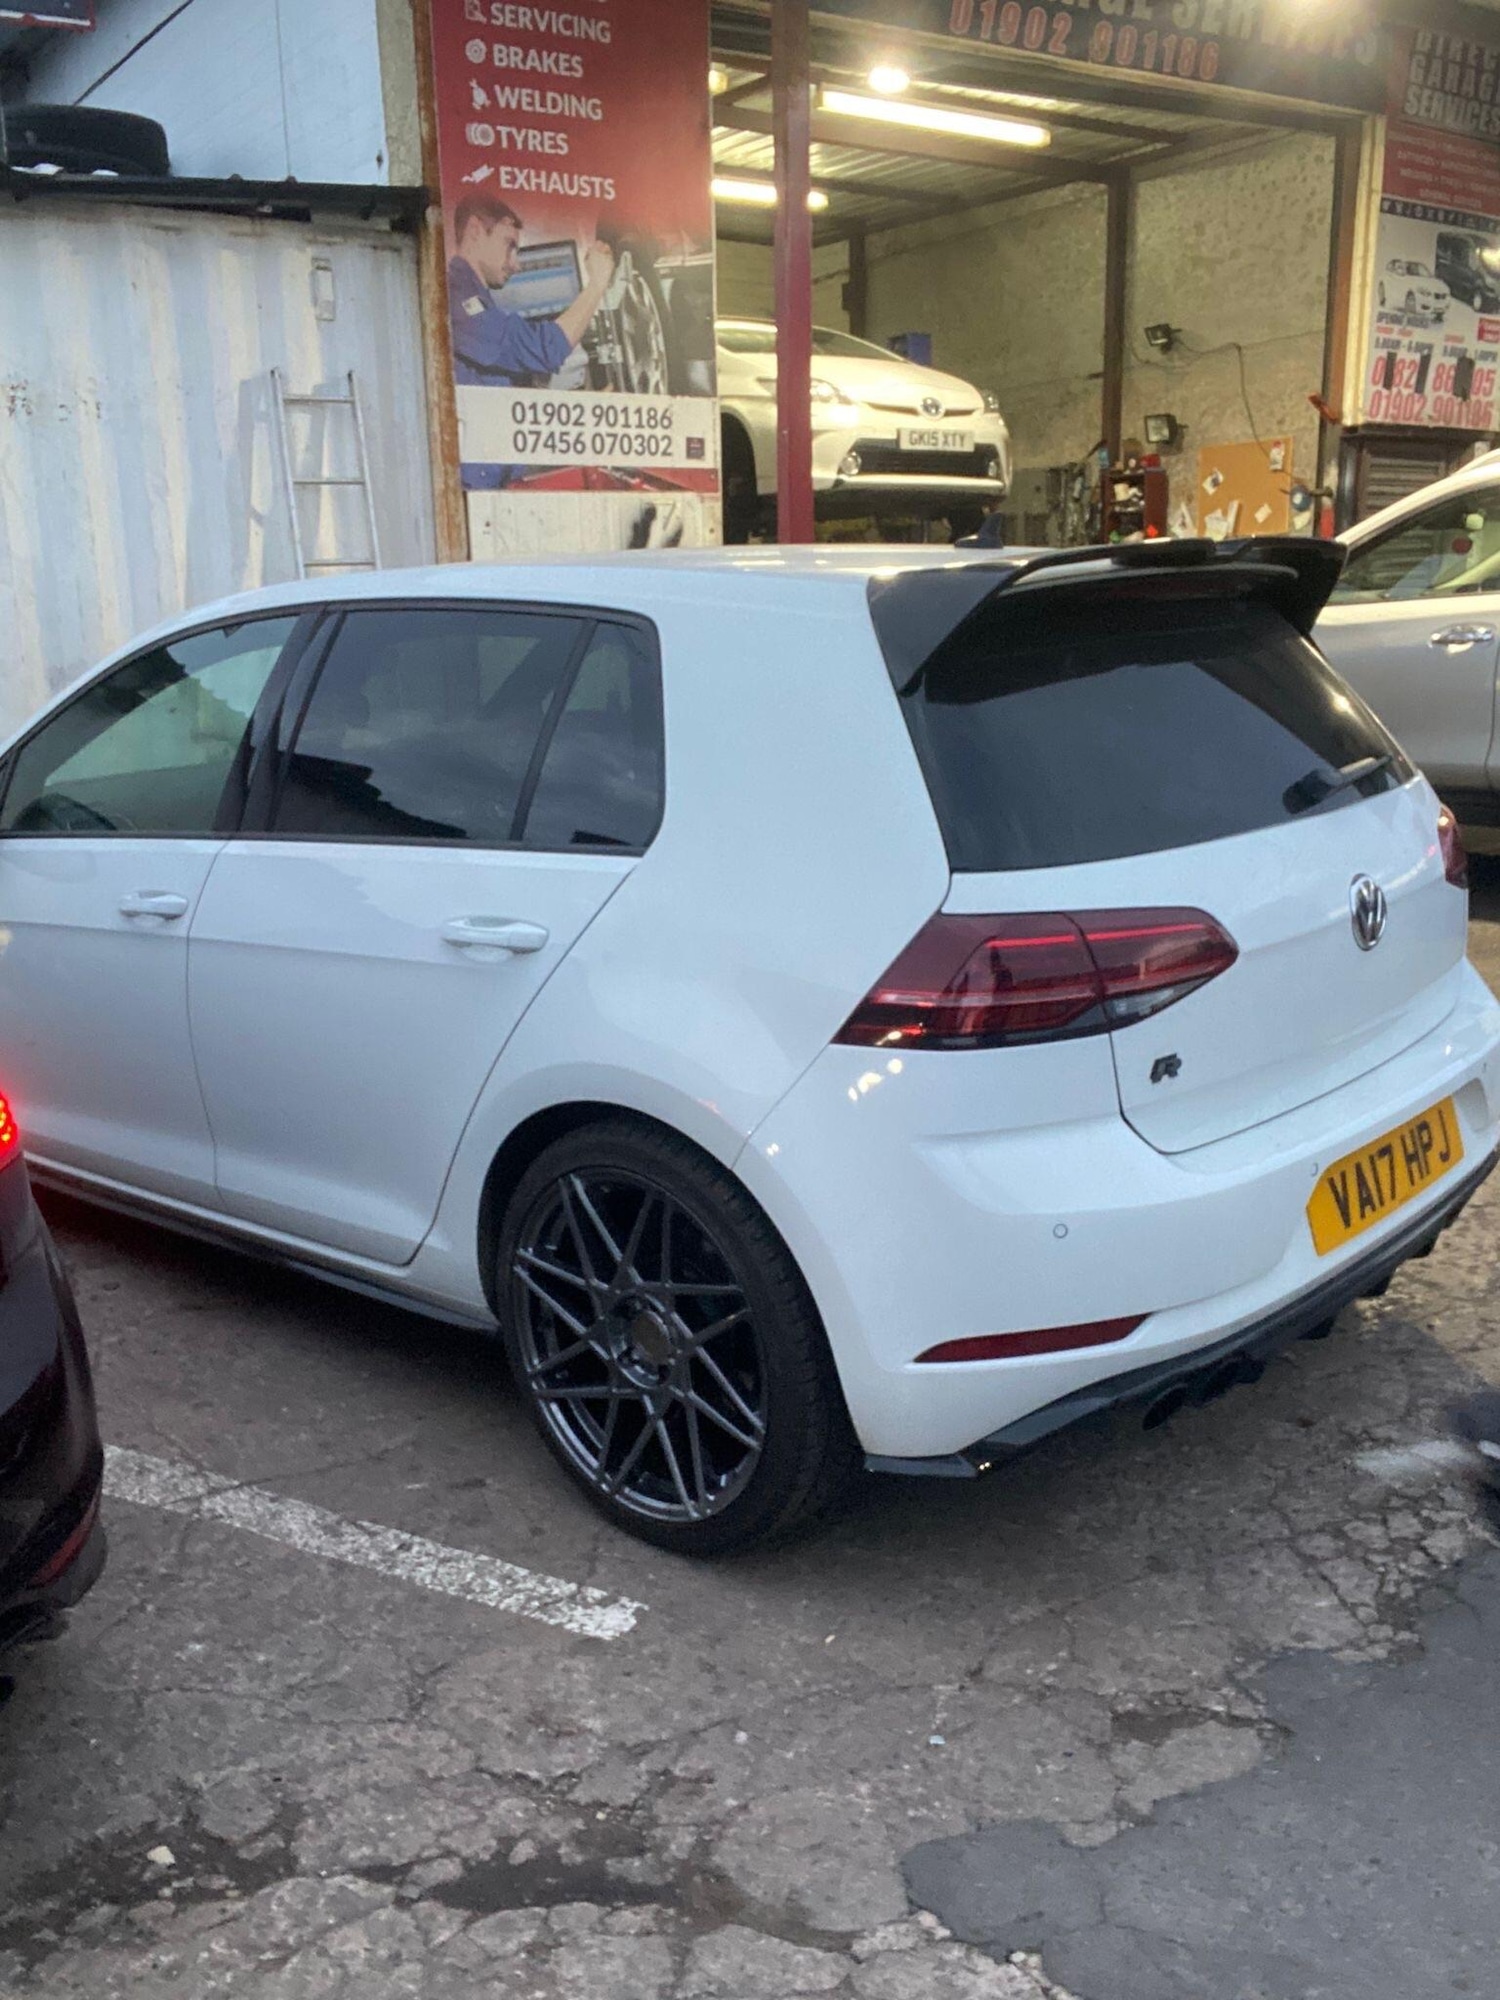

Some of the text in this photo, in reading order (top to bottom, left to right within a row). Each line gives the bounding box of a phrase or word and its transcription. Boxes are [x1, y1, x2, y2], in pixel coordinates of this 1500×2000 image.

[491, 2, 612, 44] SERVICING
[949, 0, 1072, 54] 01902
[493, 44, 584, 78] BRAKES
[1408, 54, 1500, 103] GARAG
[494, 84, 603, 121] WELDING
[496, 126, 569, 156] TYRES
[499, 166, 617, 201] EXHAUSTS
[511, 401, 673, 430] 01902 901186
[1368, 389, 1427, 422] 01902
[513, 431, 587, 455] 07456
[591, 432, 674, 457] 070302
[908, 430, 966, 448] GK15 XTY
[1149, 1052, 1183, 1085] R
[1327, 1109, 1451, 1229] VA17 HPJ
